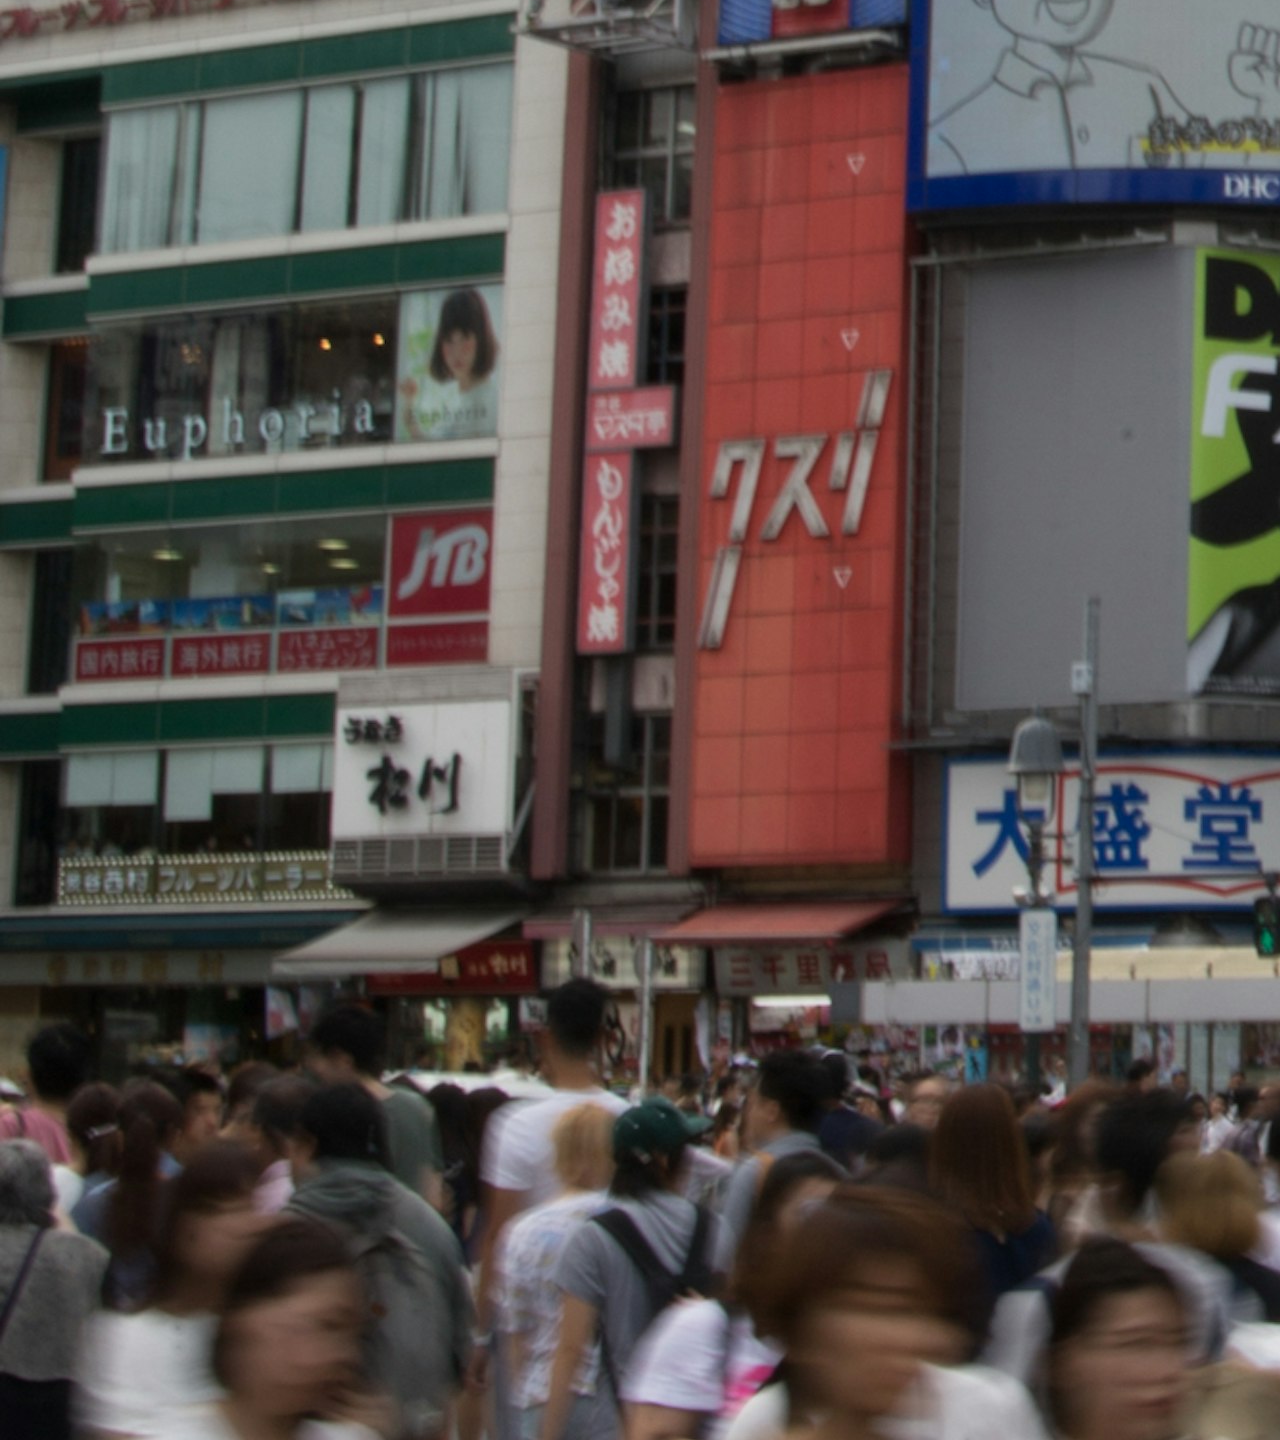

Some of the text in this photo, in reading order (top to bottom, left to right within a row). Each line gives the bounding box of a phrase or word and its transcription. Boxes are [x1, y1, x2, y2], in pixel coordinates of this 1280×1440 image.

[1223, 175, 1280, 201] DHC
[596, 200, 638, 379] お好み焼
[102, 387, 378, 460] Euphoria
[697, 369, 893, 650] クスリ
[398, 524, 489, 600] JTB
[586, 459, 624, 644] もんじゃ焼
[80, 646, 161, 675] 国内旅行
[180, 642, 262, 670] 海外旅行
[288, 630, 369, 651] ハネムーン
[343, 715, 404, 744] うなぎ
[366, 751, 463, 816] 松川
[157, 864, 324, 892] フルーツパーラー
